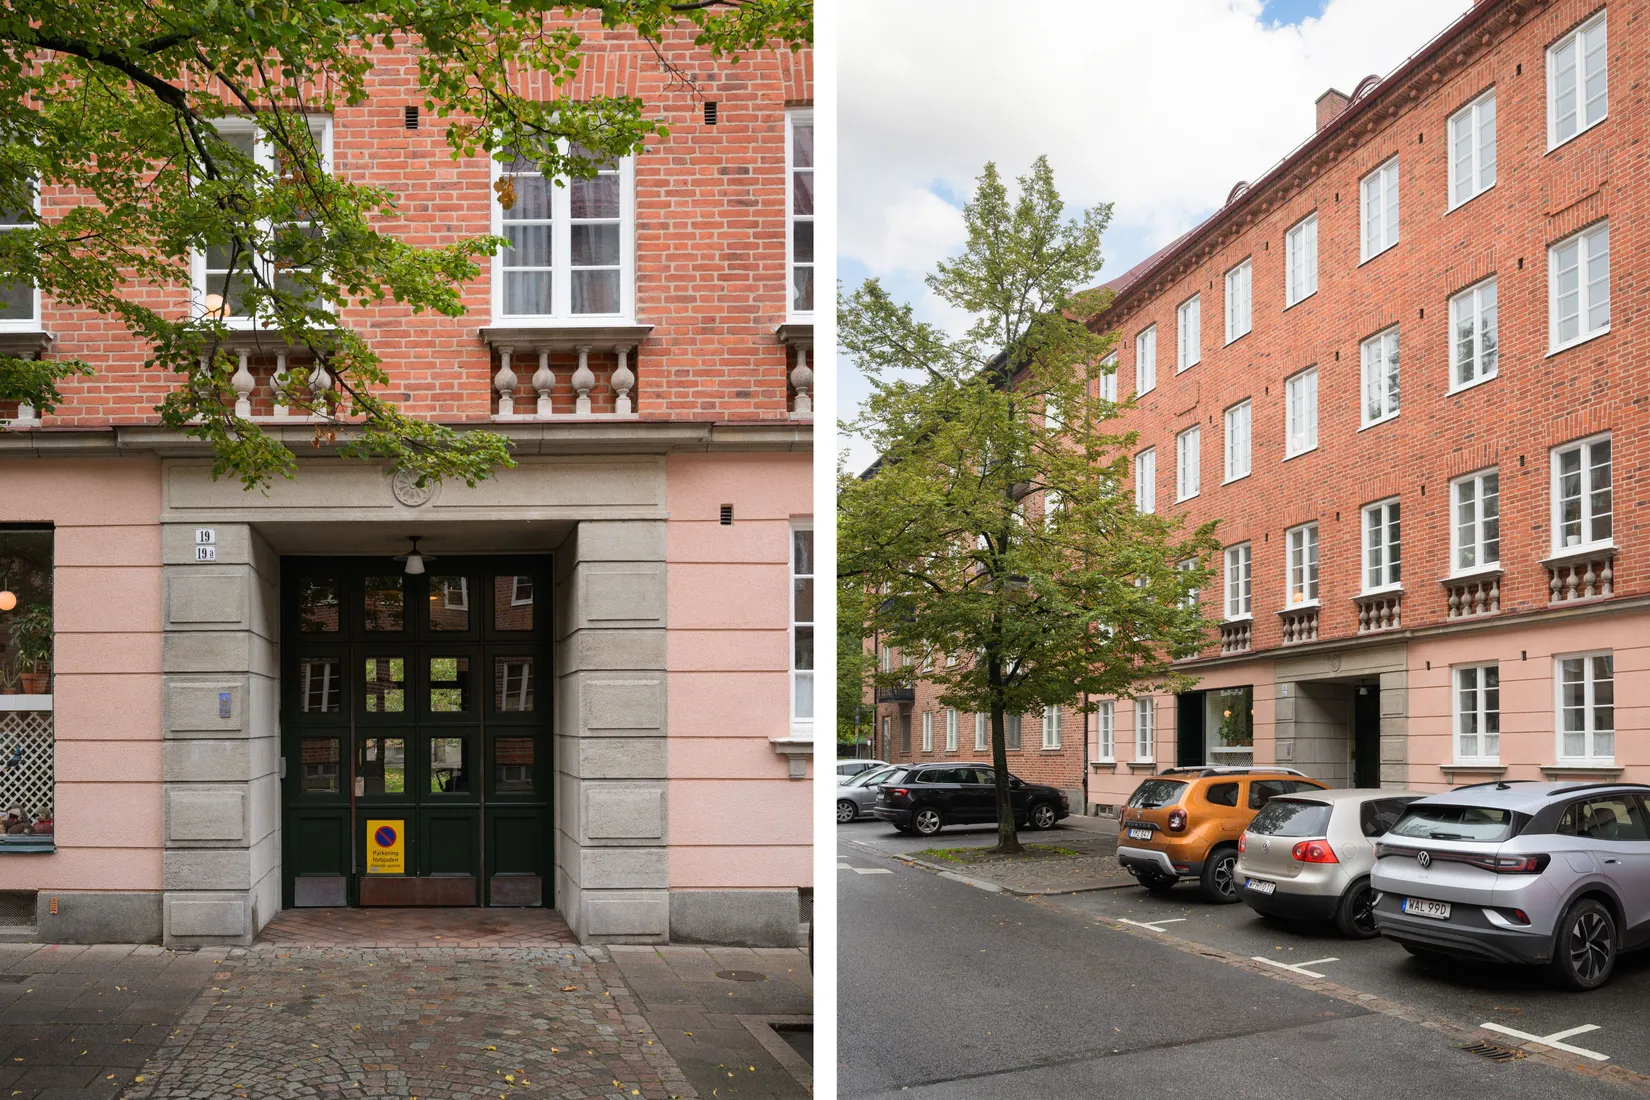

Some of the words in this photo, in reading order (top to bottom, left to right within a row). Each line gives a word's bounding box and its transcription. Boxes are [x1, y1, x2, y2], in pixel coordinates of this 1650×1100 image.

[200, 531, 210, 542] 19
[198, 548, 207, 559] 19
[1408, 899, 1425, 912] WAL
[1428, 902, 1447, 915] 99D
